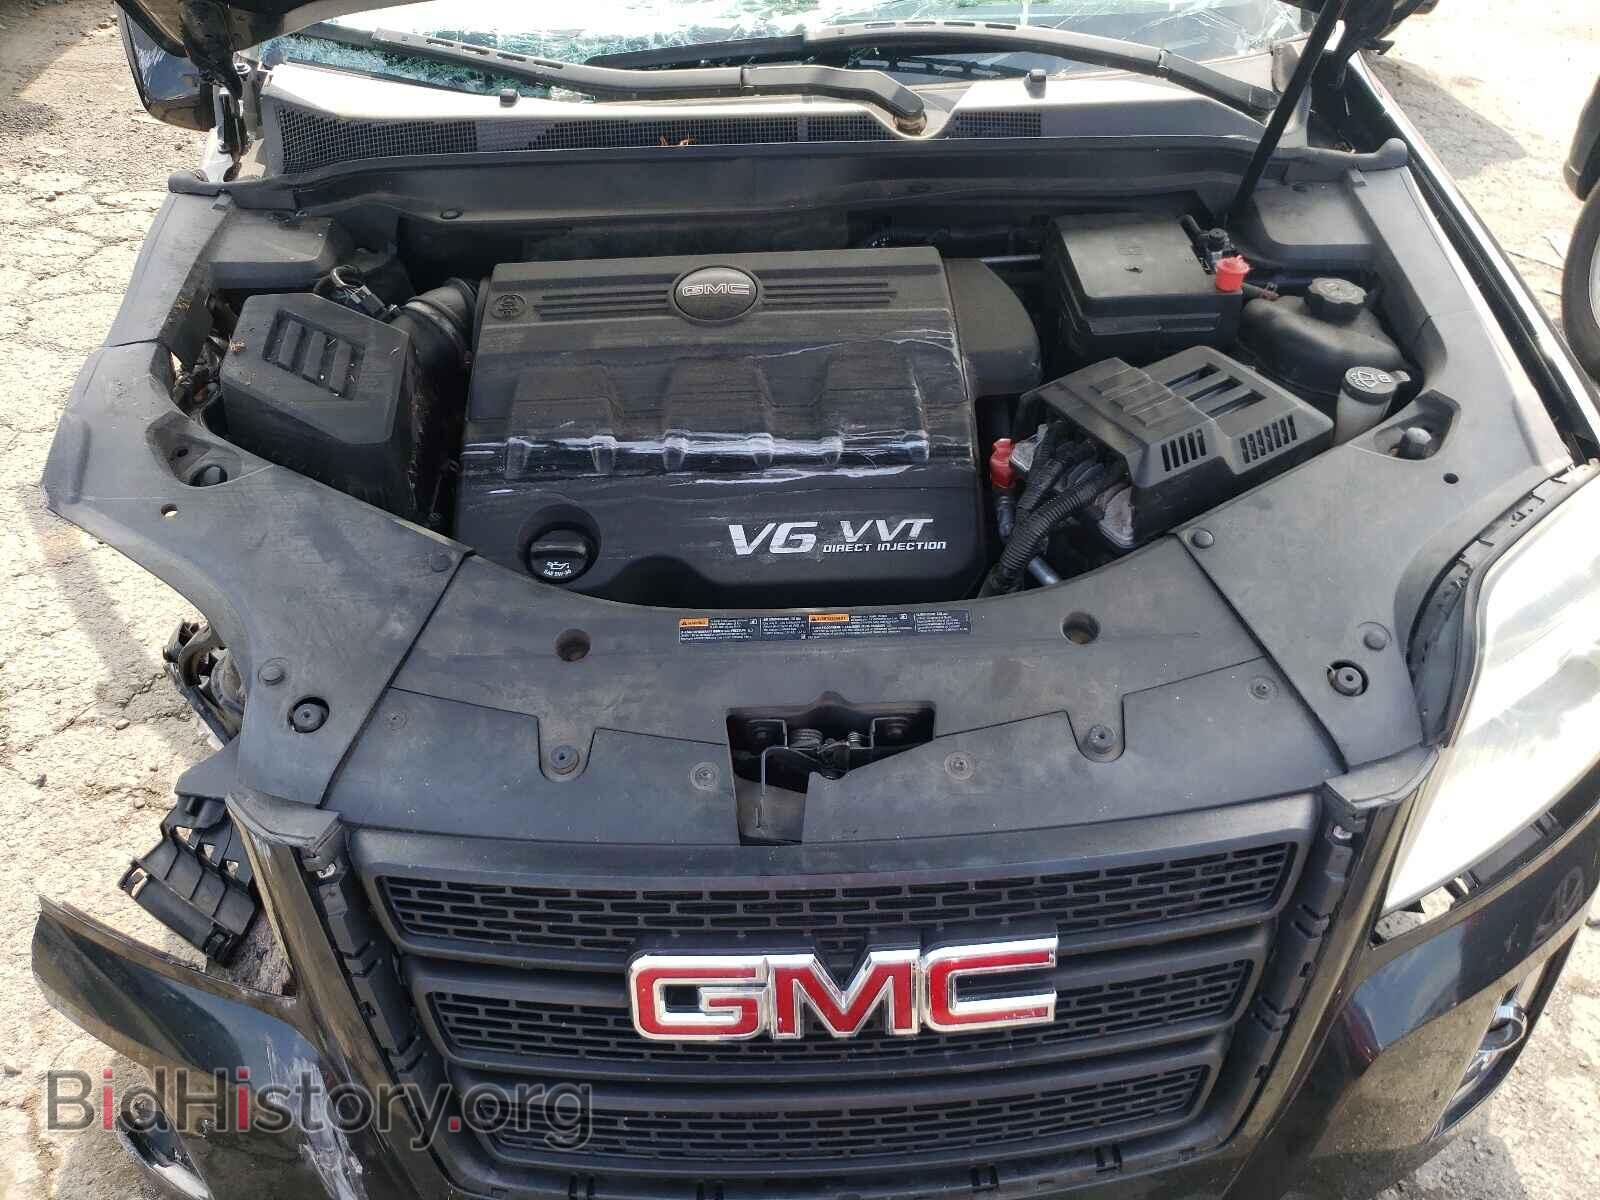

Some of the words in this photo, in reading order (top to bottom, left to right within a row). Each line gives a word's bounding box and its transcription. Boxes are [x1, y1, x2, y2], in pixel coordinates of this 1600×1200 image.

[682, 283, 750, 297] GMC
[728, 522, 818, 555] V6
[840, 518, 934, 542] VVT
[823, 543, 872, 553] DIRECT
[877, 541, 947, 551] INJECTION
[628, 936, 1058, 1040] GMC
